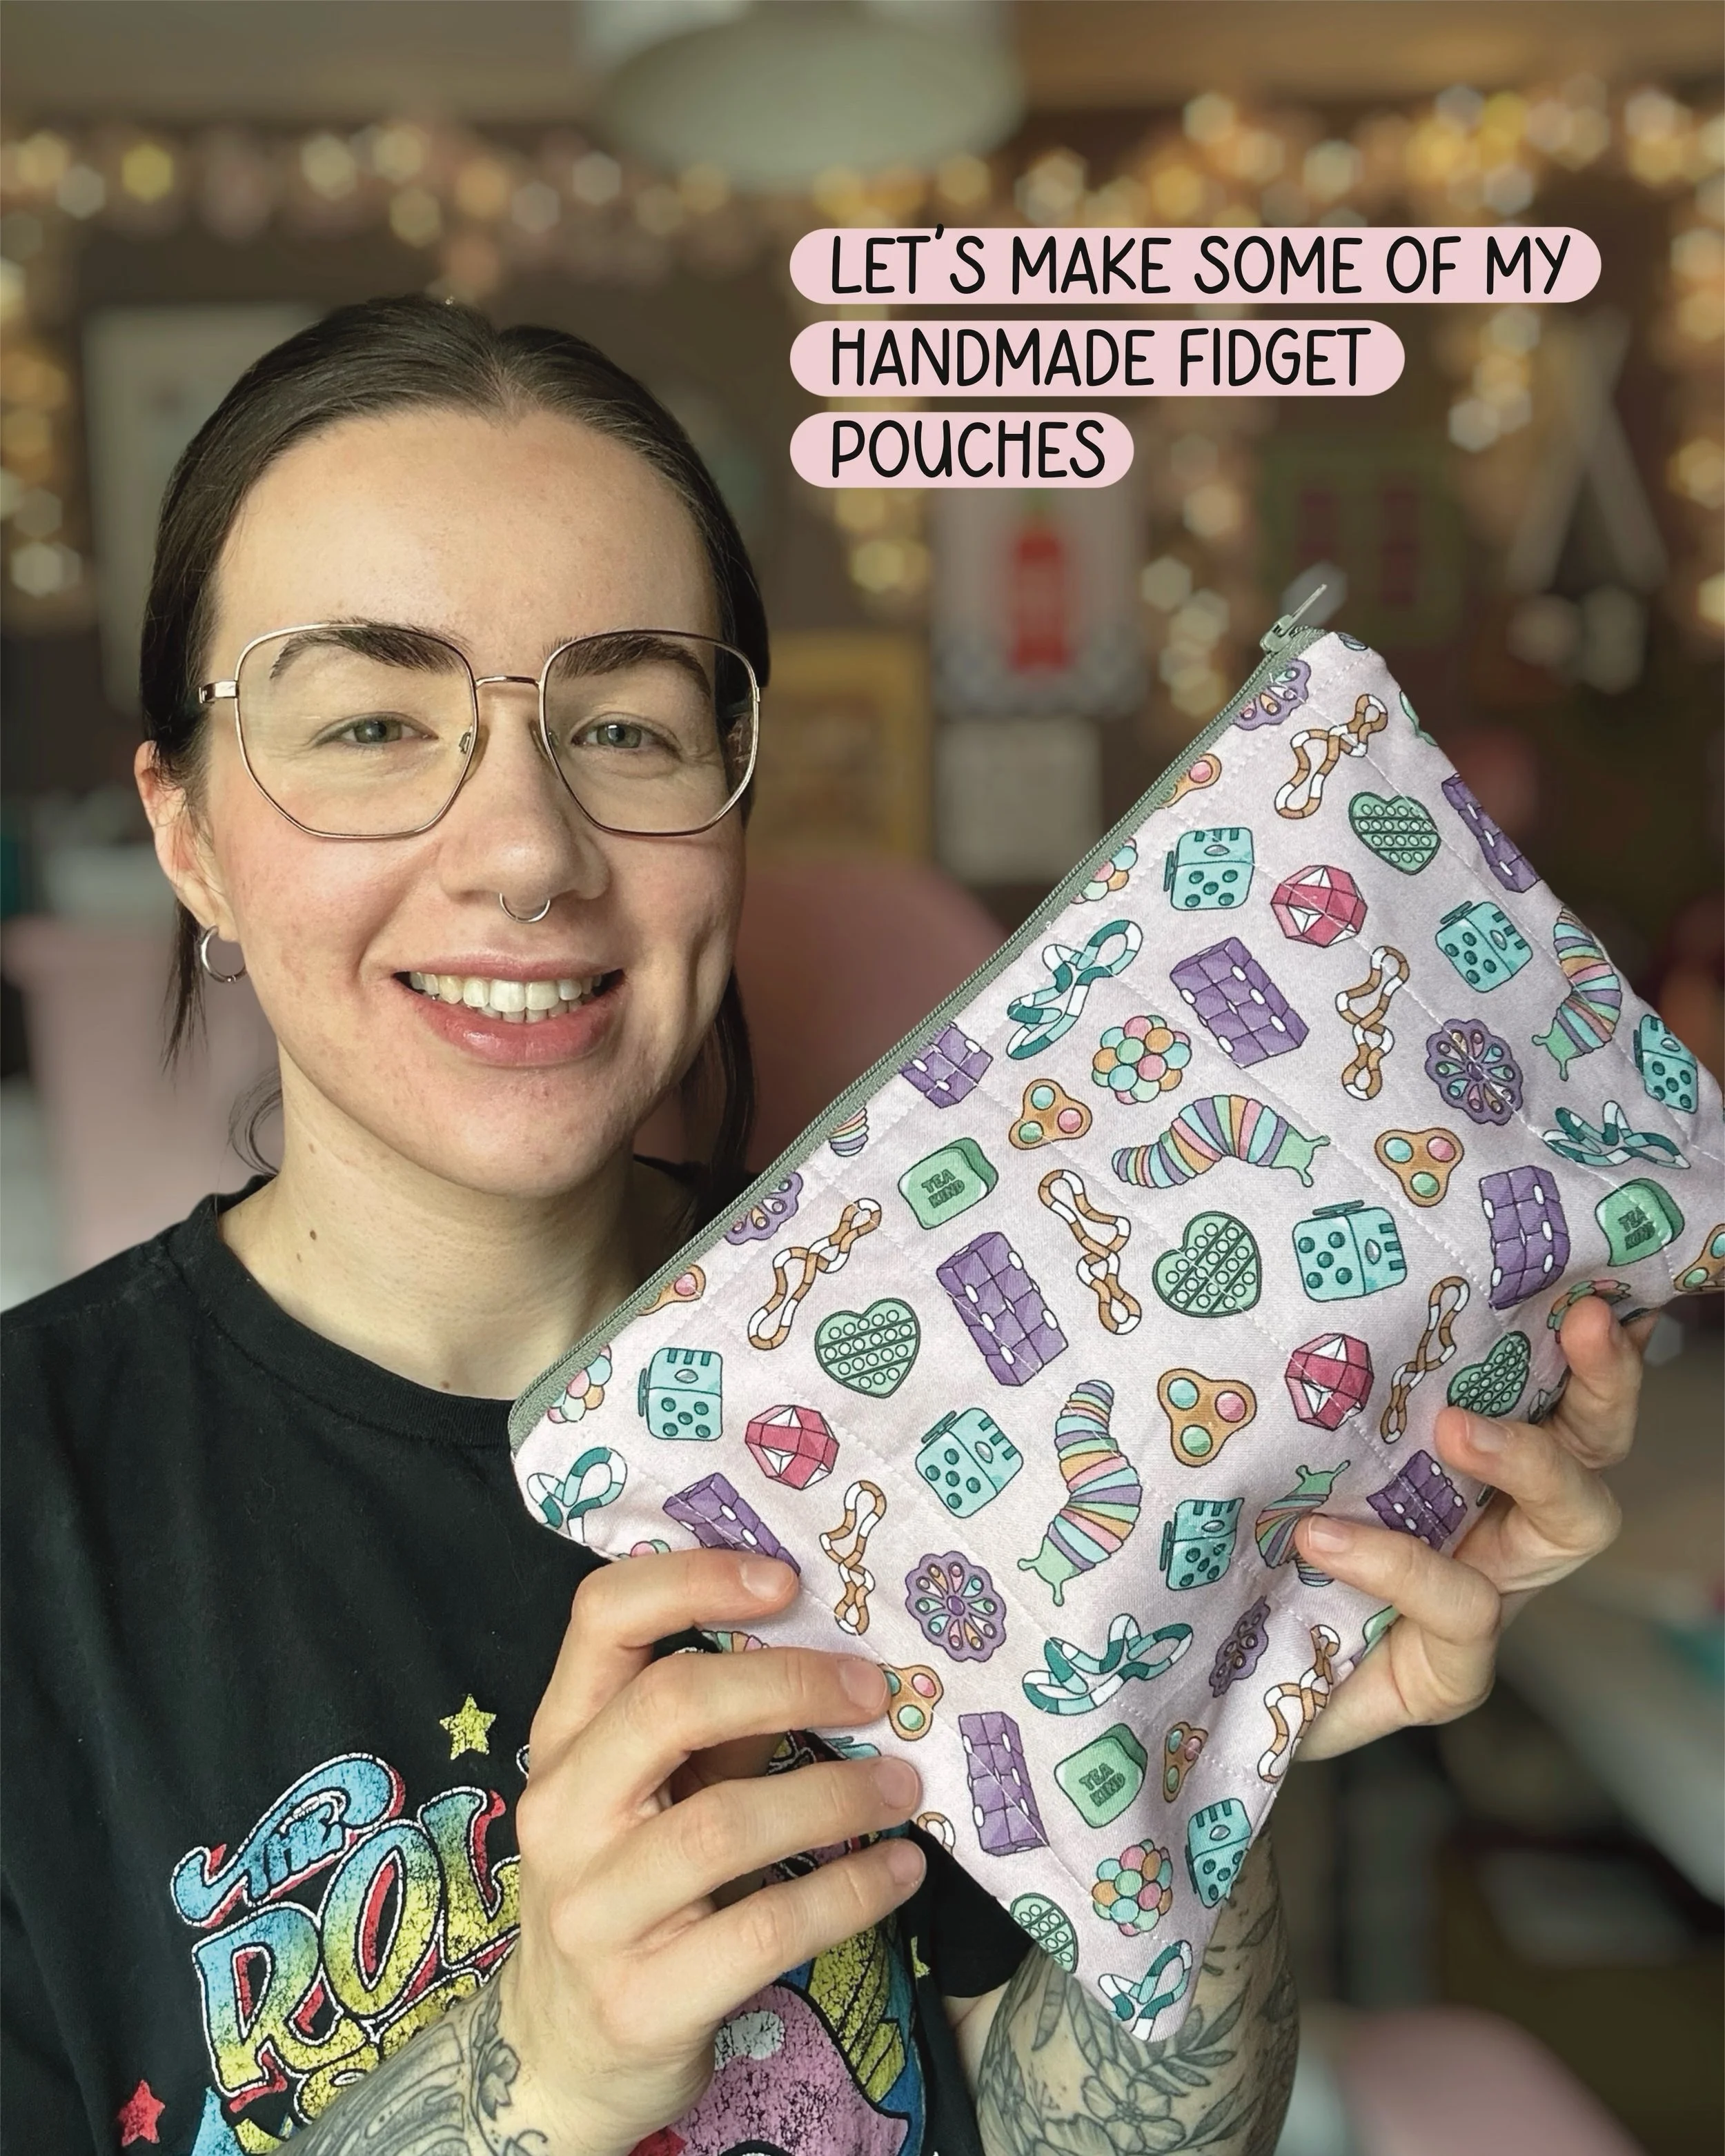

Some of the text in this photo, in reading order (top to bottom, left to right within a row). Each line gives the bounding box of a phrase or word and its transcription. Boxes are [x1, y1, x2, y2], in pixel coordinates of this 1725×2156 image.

[921, 1169, 956, 1194] TEA
[928, 1179, 965, 1208] KIND
[1617, 1206, 1649, 1233] TEA
[1078, 1763, 1114, 1790] TEA
[192, 1786, 522, 2099] ROL
